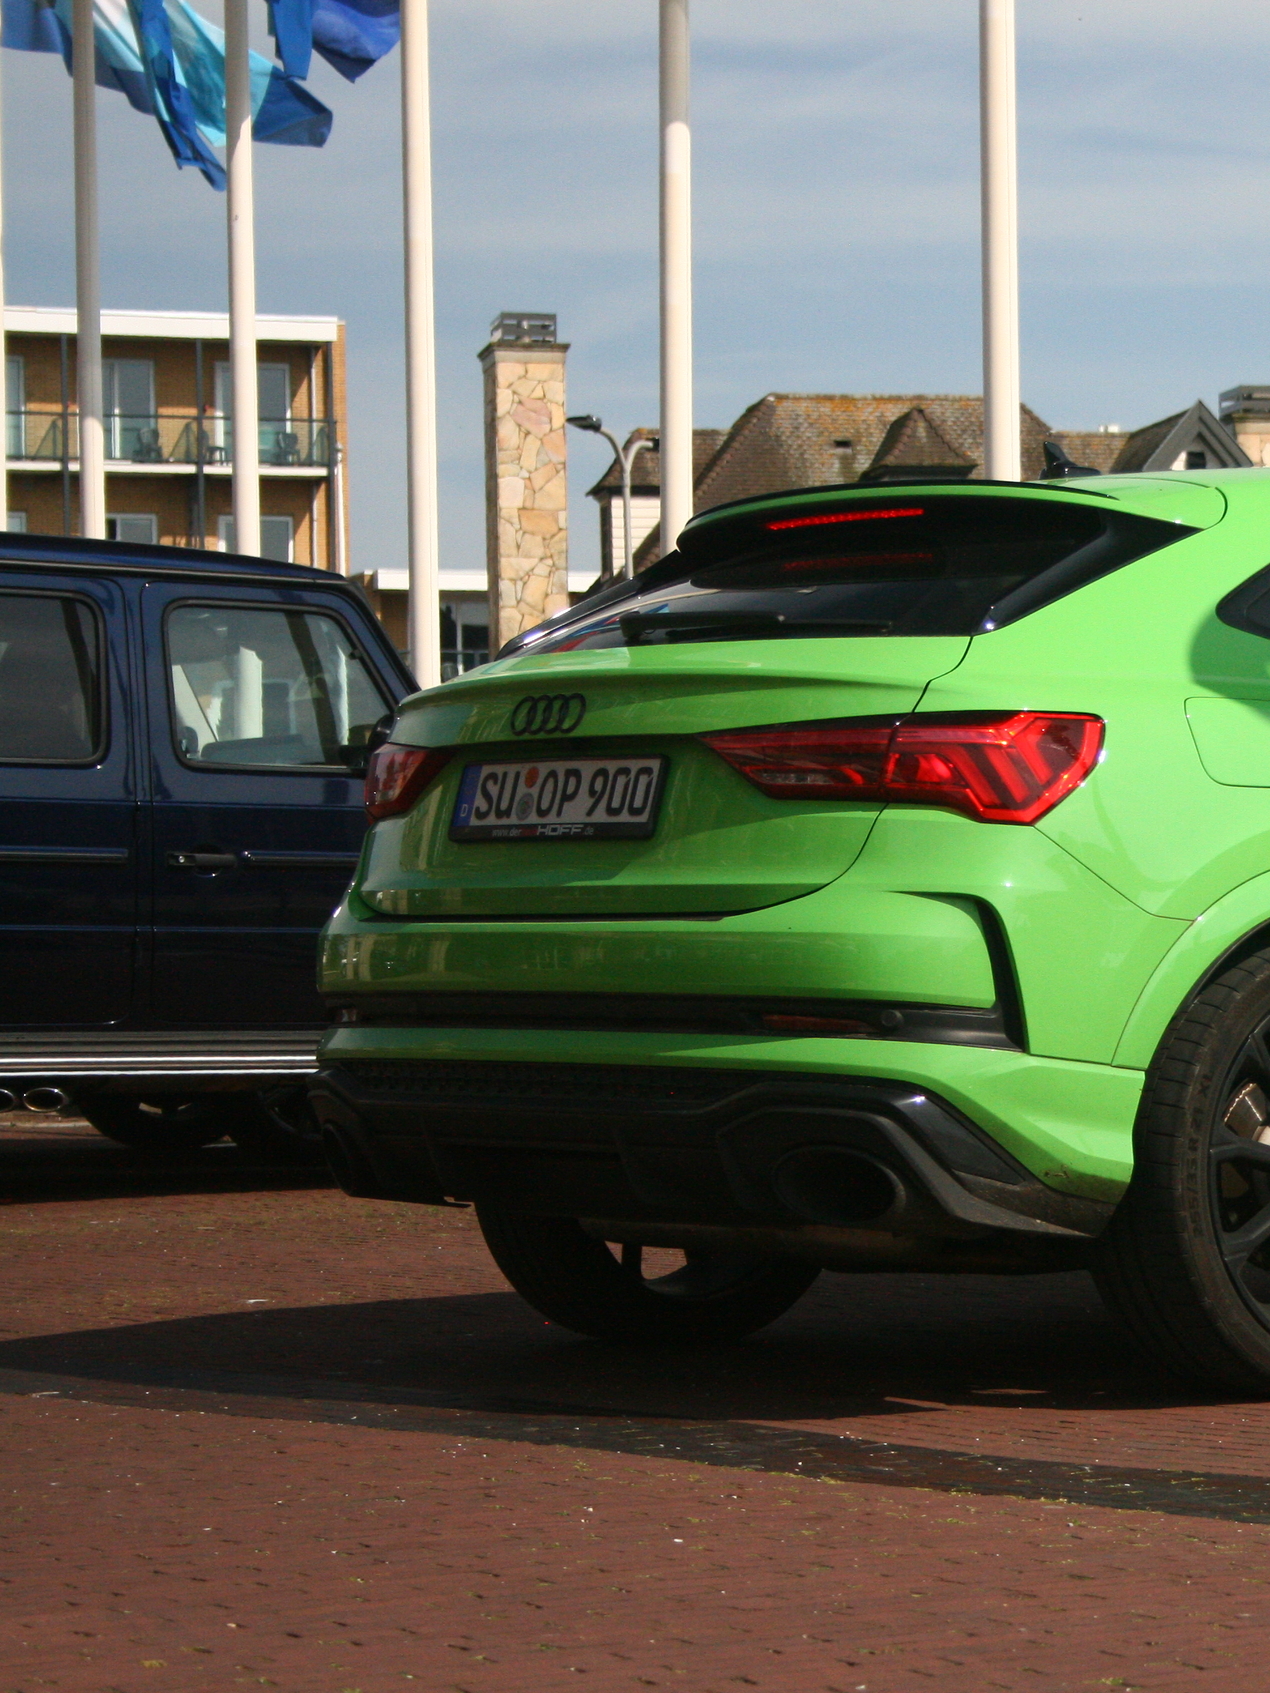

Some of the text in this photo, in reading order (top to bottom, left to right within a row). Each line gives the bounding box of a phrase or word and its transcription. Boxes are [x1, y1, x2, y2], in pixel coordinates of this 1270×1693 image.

[460, 803, 469, 817] D
[474, 767, 654, 821] SU OP 900
